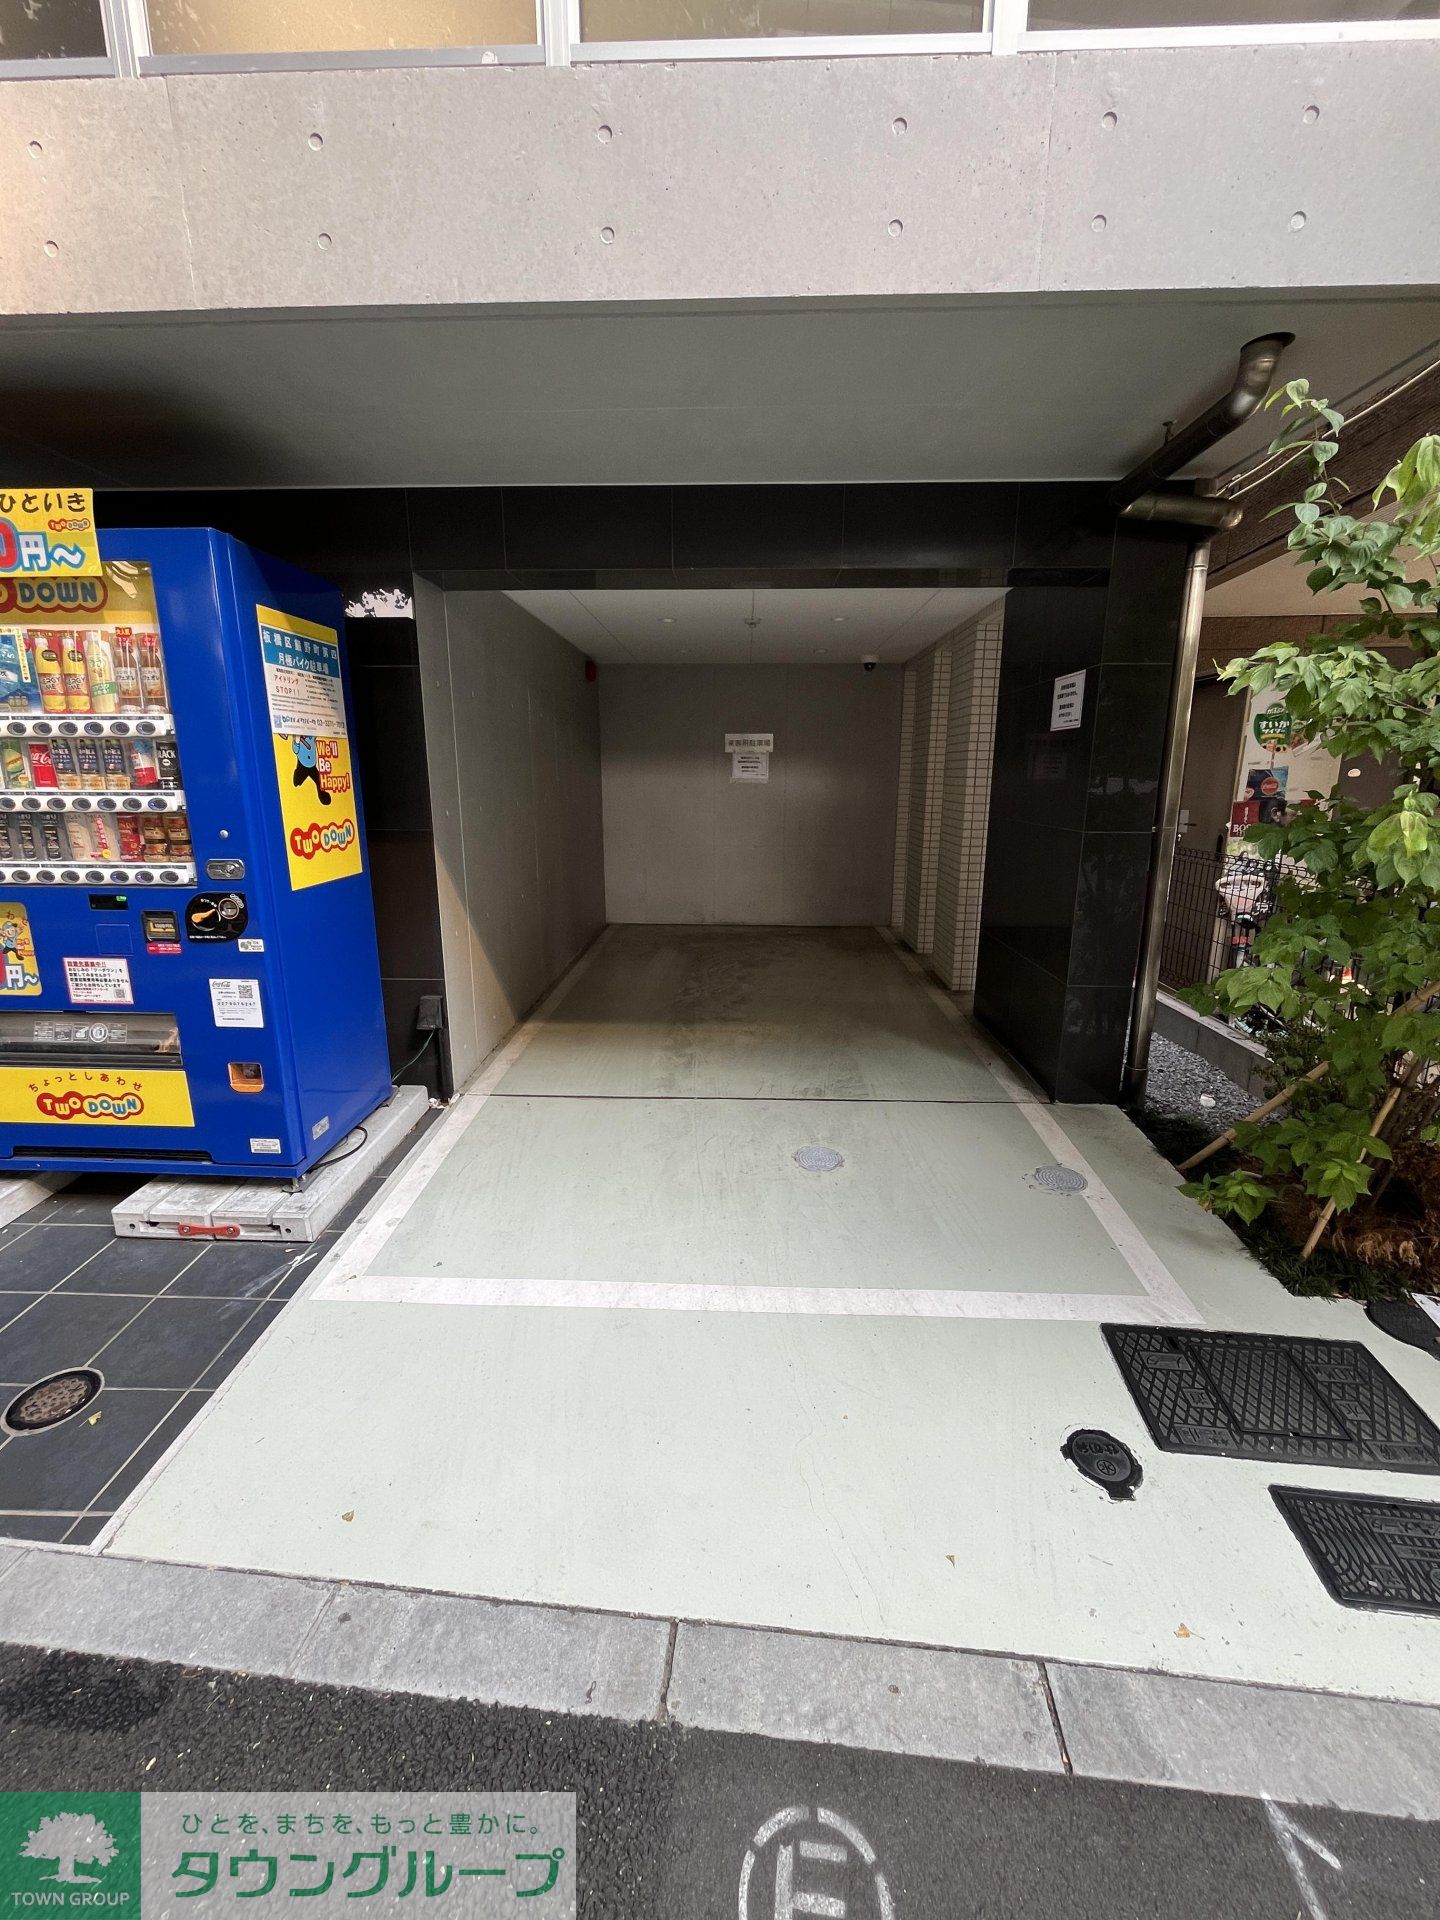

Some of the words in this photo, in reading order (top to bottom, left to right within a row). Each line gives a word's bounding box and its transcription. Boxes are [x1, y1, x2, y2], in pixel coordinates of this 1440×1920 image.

[0, 492, 86, 513] ひといき
[19, 582, 98, 603] DOWN
[318, 740, 338, 757] We'll
[318, 758, 331, 772] Be
[320, 773, 350, 792] Happy!
[295, 829, 319, 854] TWO
[324, 825, 351, 847] DOWN
[29, 1072, 142, 1092] ちょっとしあわせ
[43, 1098, 82, 1116] TWO
[88, 1098, 138, 1115] DOWN
